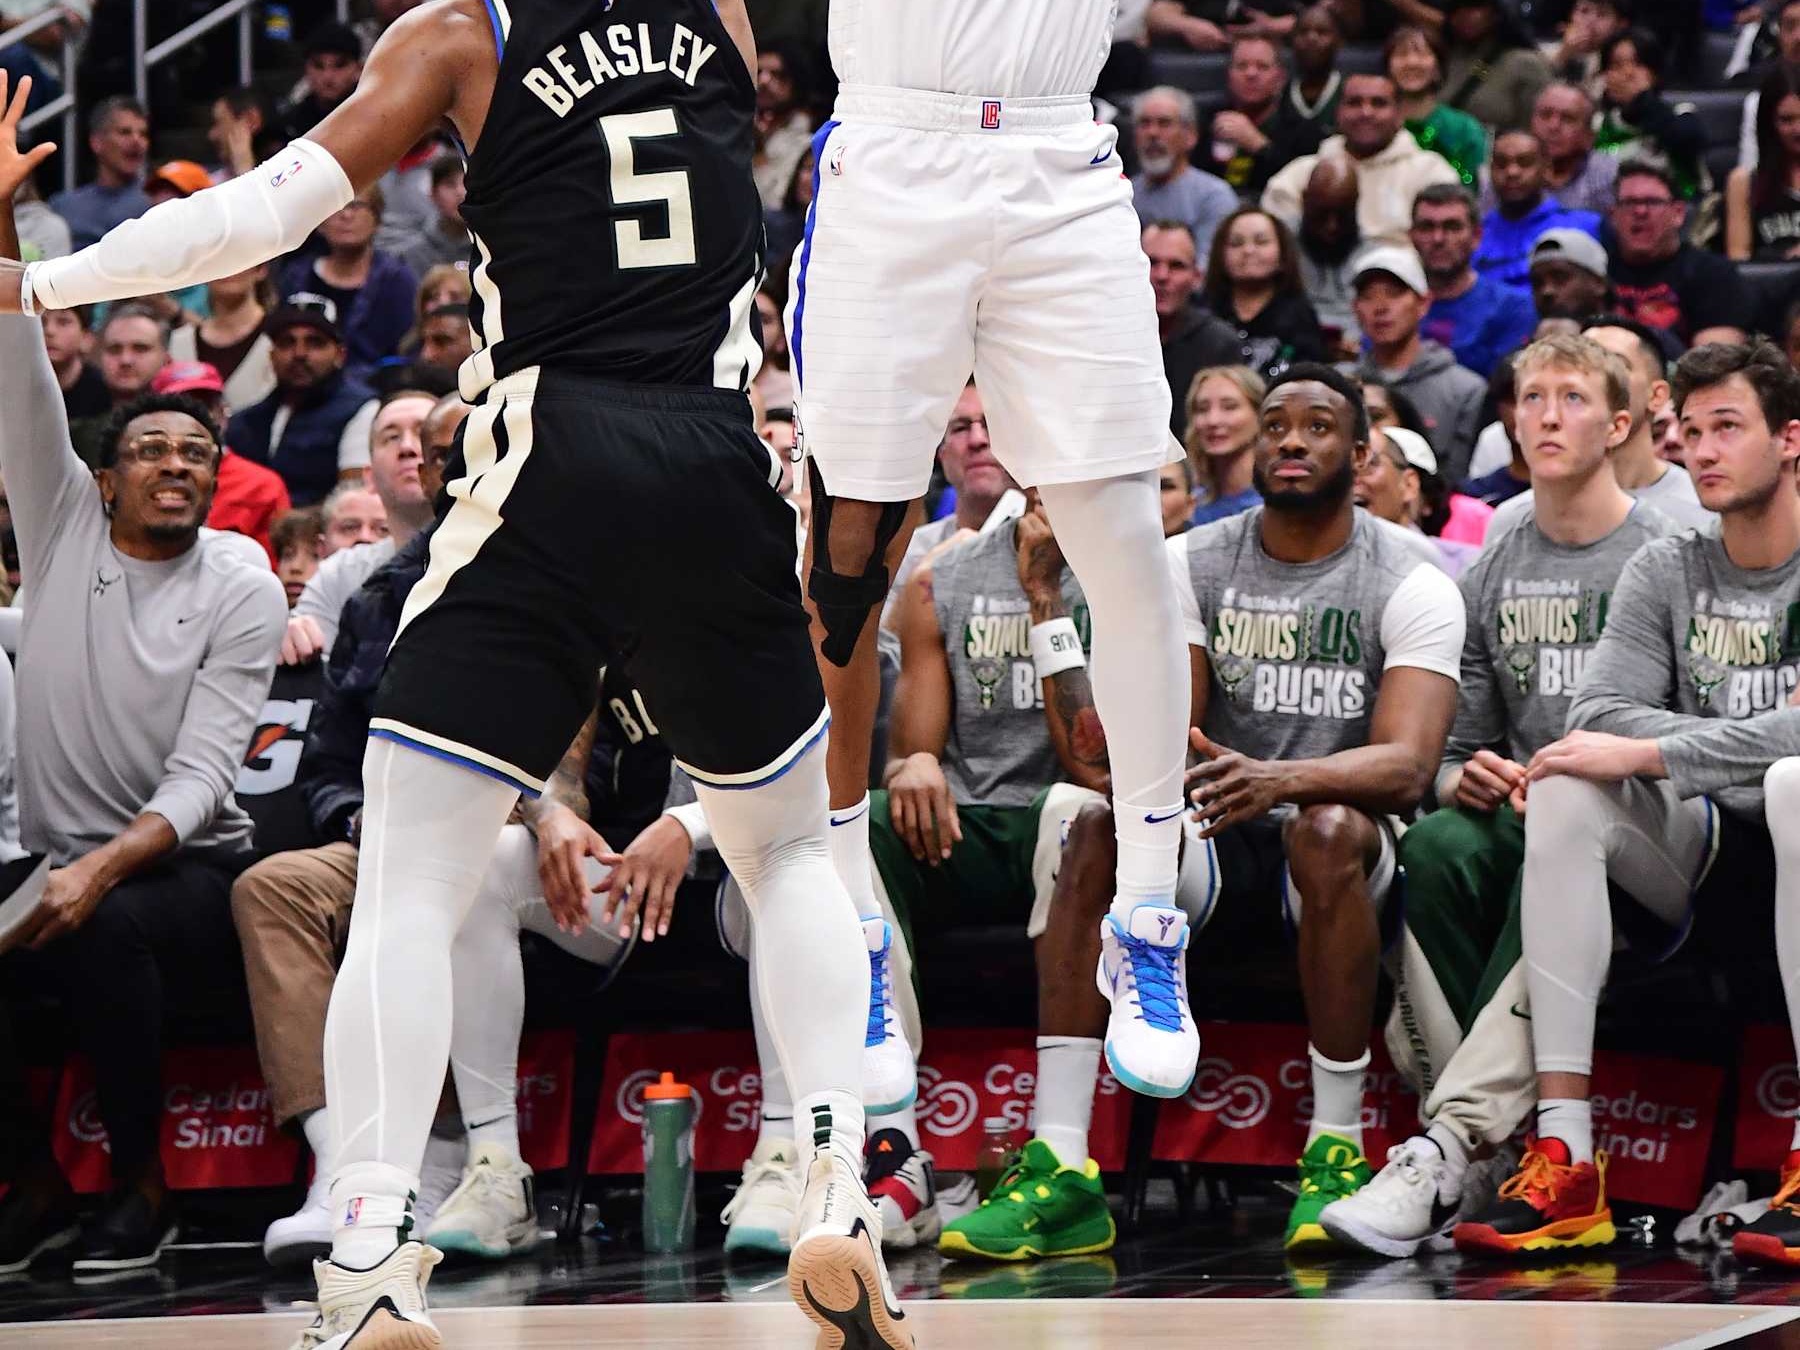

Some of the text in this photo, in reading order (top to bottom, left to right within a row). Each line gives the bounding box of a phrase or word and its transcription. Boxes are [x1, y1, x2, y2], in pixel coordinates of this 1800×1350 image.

[521, 22, 717, 118] BEASLEY
[598, 106, 697, 271] 5
[1213, 606, 1299, 662] SOMOS
[1499, 596, 1579, 645] SOMOS
[1690, 612, 1770, 667] SOMOS
[1252, 663, 1366, 720] BUCKS
[1727, 662, 1800, 720] BUC
[173, 1114, 268, 1149] Sinai
[1594, 1122, 1672, 1164] inai
